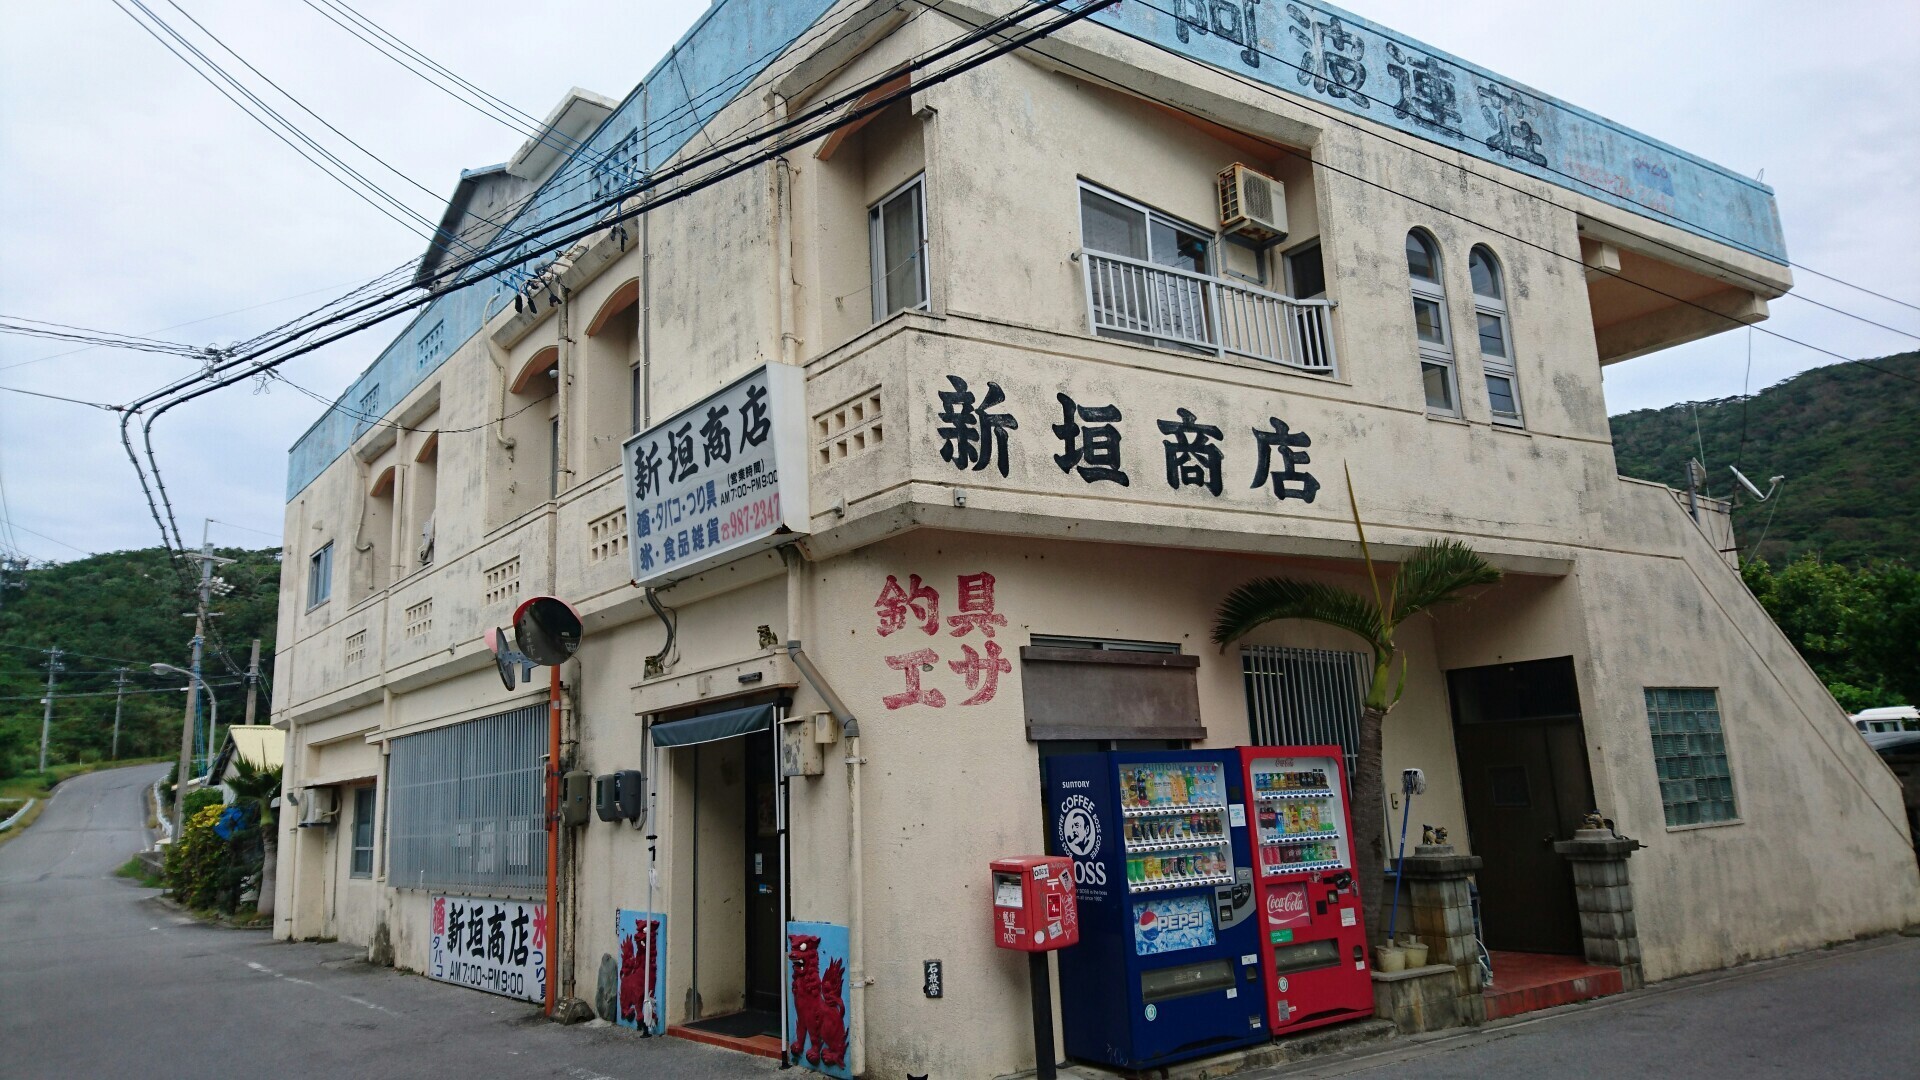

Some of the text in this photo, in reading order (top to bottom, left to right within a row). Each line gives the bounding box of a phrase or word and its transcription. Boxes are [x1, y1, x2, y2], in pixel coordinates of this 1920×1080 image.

[634, 384, 771, 501] 新垣商店
[938, 375, 1321, 504] 新垣商店
[874, 571, 1008, 638] 釣具
[882, 640, 1013, 710] エサ
[1061, 794, 1096, 814] COFFEE
[1062, 780, 1090, 789] SUNTORY
[1074, 860, 1107, 886] OSS
[447, 902, 530, 967] 新垣商店
[1003, 932, 1016, 944] POST
[1157, 911, 1204, 932] PEPSI
